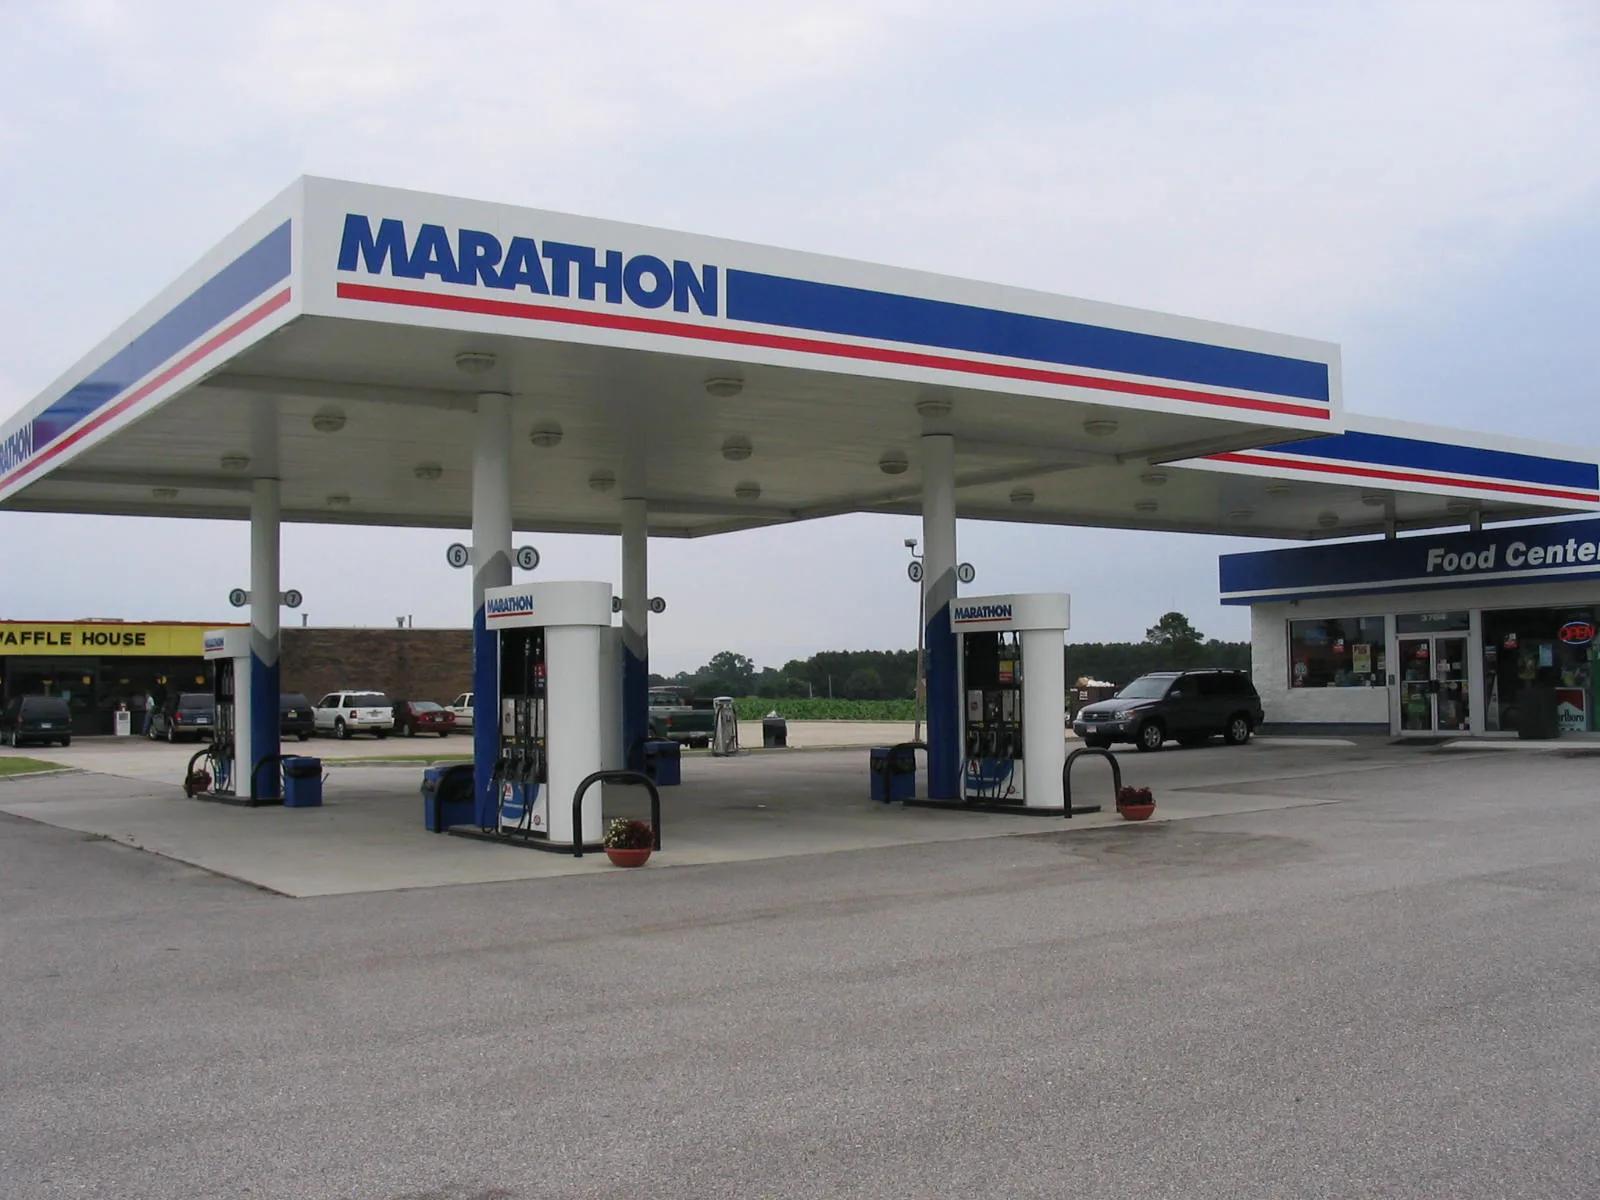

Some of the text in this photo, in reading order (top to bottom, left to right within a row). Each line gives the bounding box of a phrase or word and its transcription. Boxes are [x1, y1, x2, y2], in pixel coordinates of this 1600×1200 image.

[337, 213, 718, 317] MARATHON
[455, 550, 461, 562] 6
[524, 552, 531, 564] 5
[1426, 538, 1600, 573] Food Cente
[912, 567, 918, 577] 2
[487, 595, 533, 613] MARATHON
[954, 604, 1012, 620] MARATHON
[0, 632, 146, 646] AFFLE HOUSE
[1558, 626, 1595, 641] OPEN
[1559, 709, 1585, 722] rlboro
